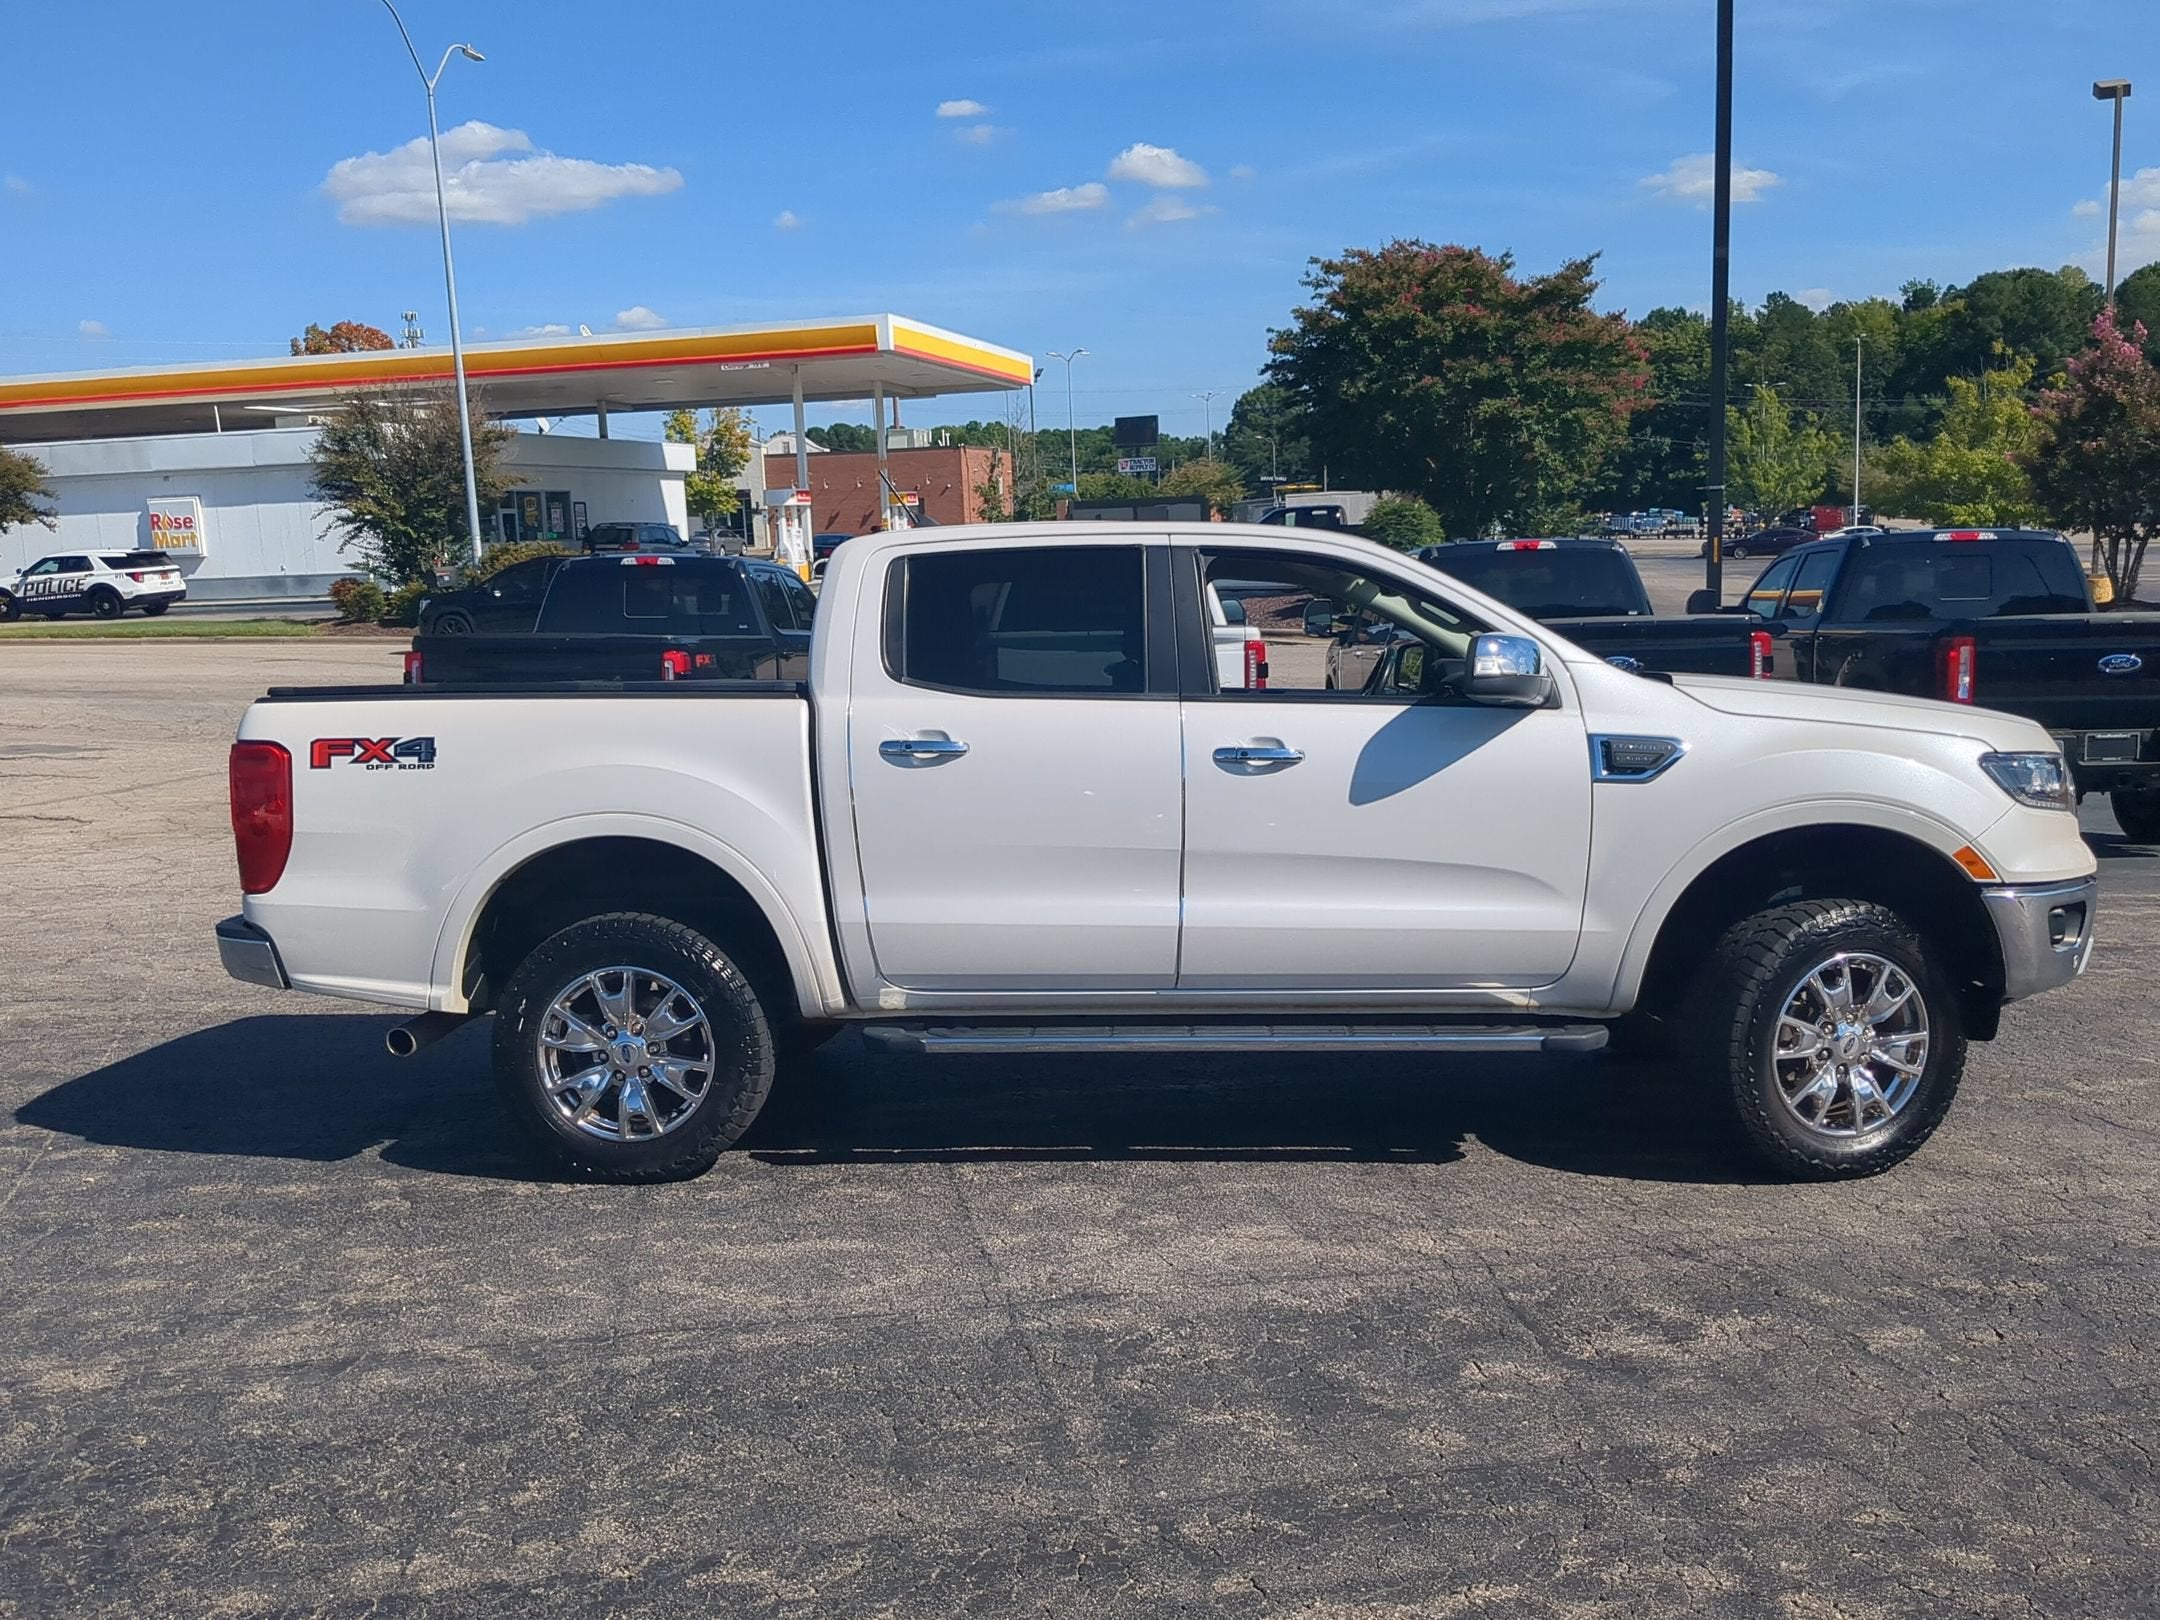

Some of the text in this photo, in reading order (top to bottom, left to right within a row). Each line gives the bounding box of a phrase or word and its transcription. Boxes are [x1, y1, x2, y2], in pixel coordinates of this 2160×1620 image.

[150, 510, 194, 530] Rose
[153, 531, 198, 549] Mart
[24, 577, 86, 596] POLICE
[27, 593, 82, 602] HENDERSON
[310, 737, 436, 769] FX4
